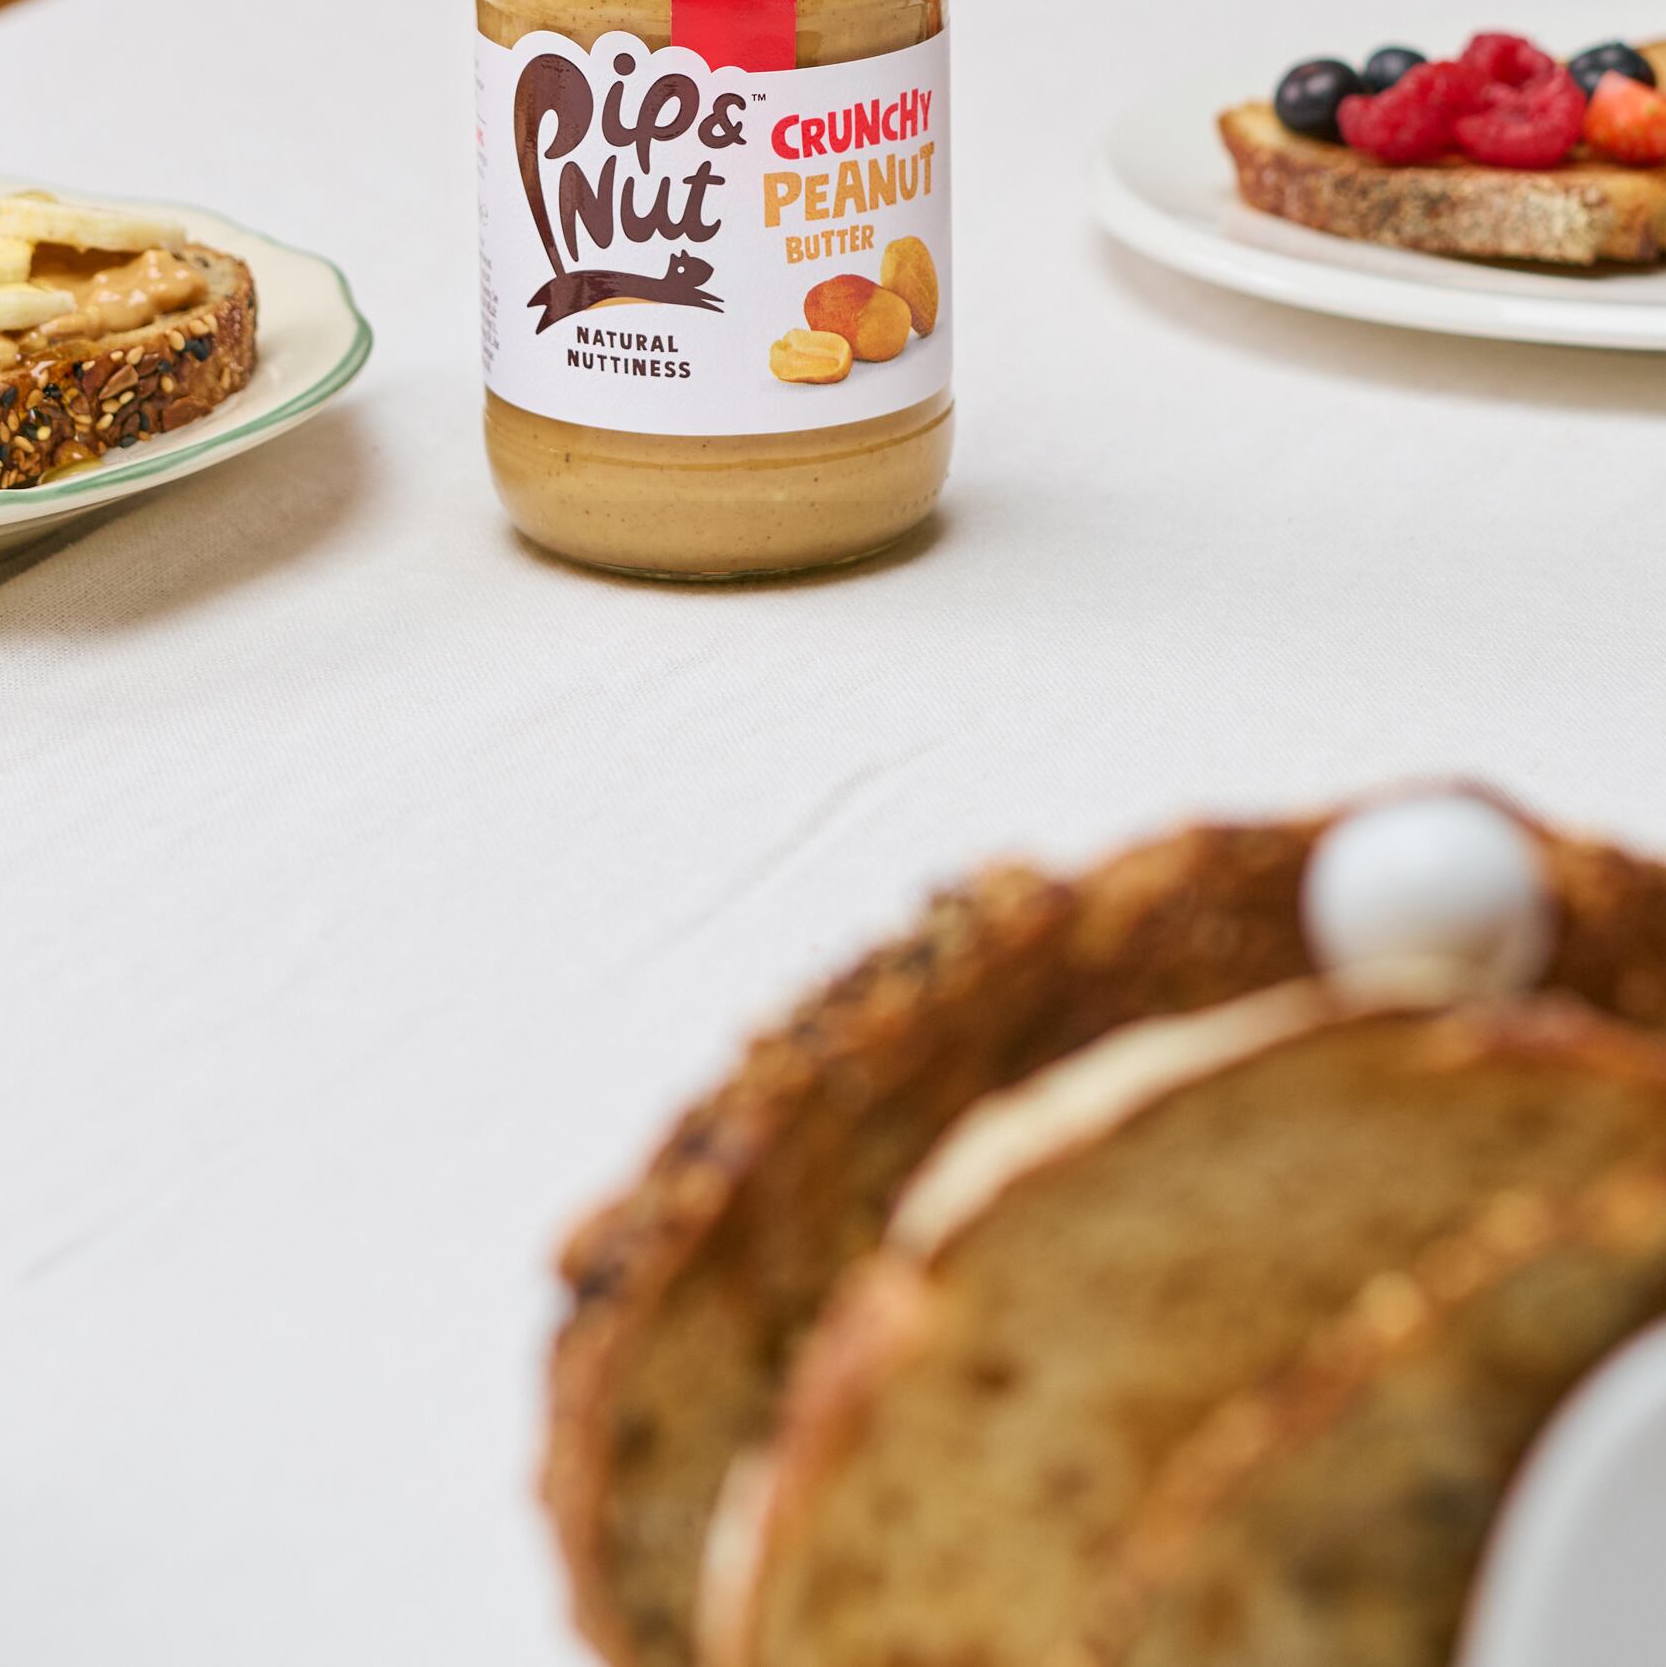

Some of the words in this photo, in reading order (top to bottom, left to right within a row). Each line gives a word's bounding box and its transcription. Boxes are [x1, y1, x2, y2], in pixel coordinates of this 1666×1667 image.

[771, 88, 932, 160] CRUNCHY
[559, 160, 725, 262] Nut
[763, 141, 935, 228] PEANUT
[785, 224, 874, 264] BUTTER
[567, 348, 691, 379] NUTTINESS
[576, 325, 679, 353] NATURAL
